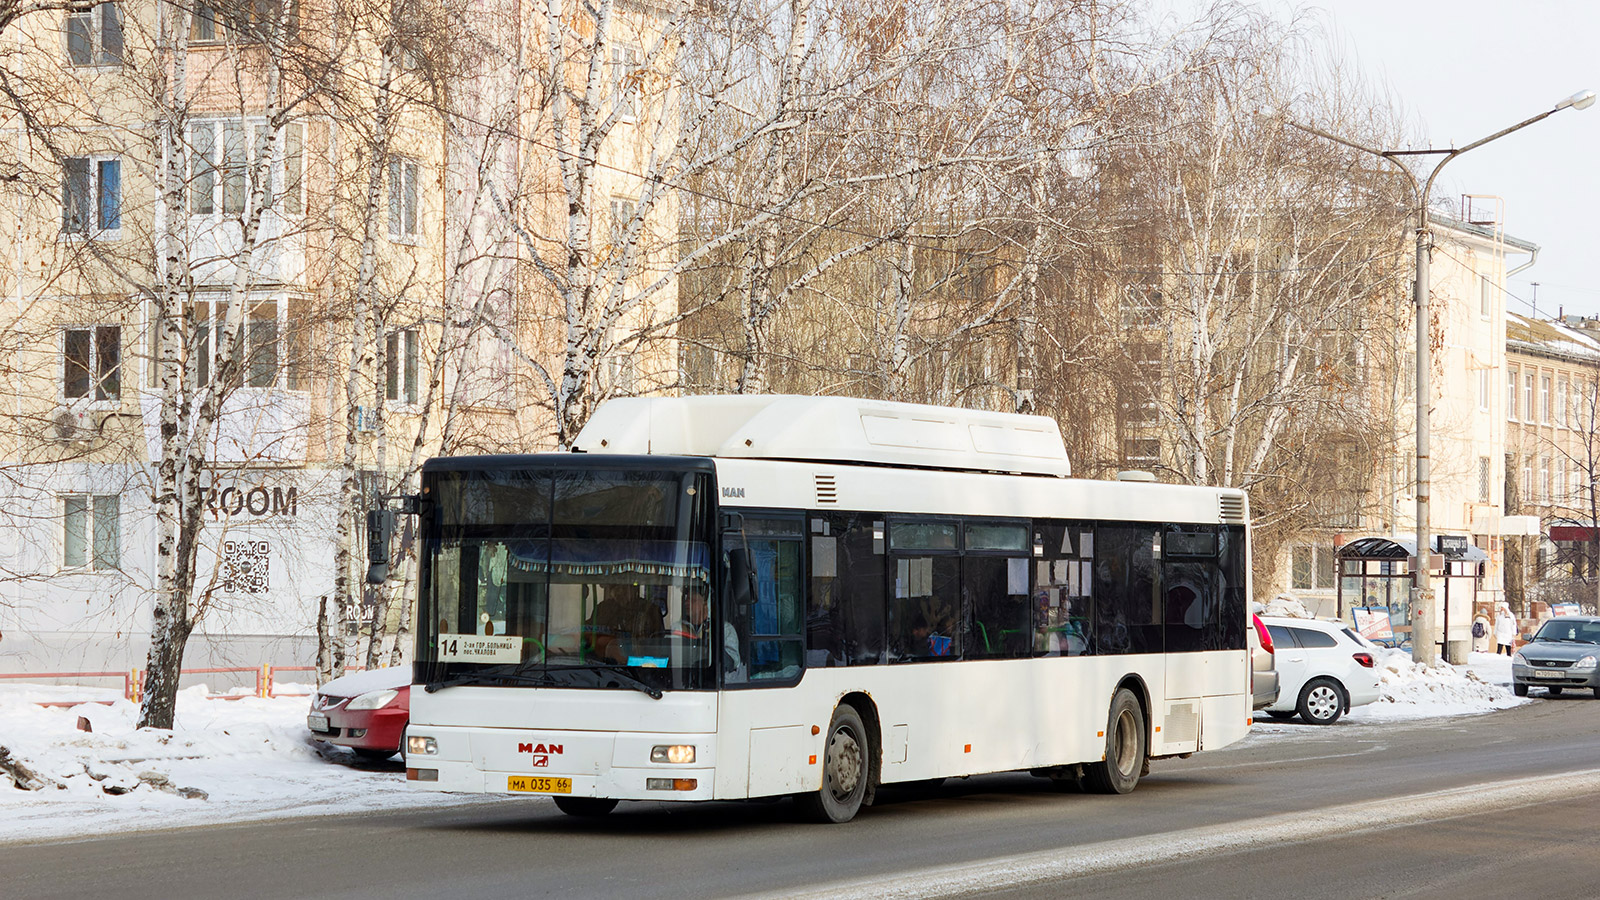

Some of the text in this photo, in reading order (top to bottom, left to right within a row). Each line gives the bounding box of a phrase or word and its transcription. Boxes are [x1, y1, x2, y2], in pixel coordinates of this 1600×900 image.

[722, 487, 745, 498] MAN
[199, 487, 297, 515] ROOM
[441, 639, 458, 656] 14
[518, 743, 563, 754] MAN
[512, 779, 568, 790] МА 035 66
